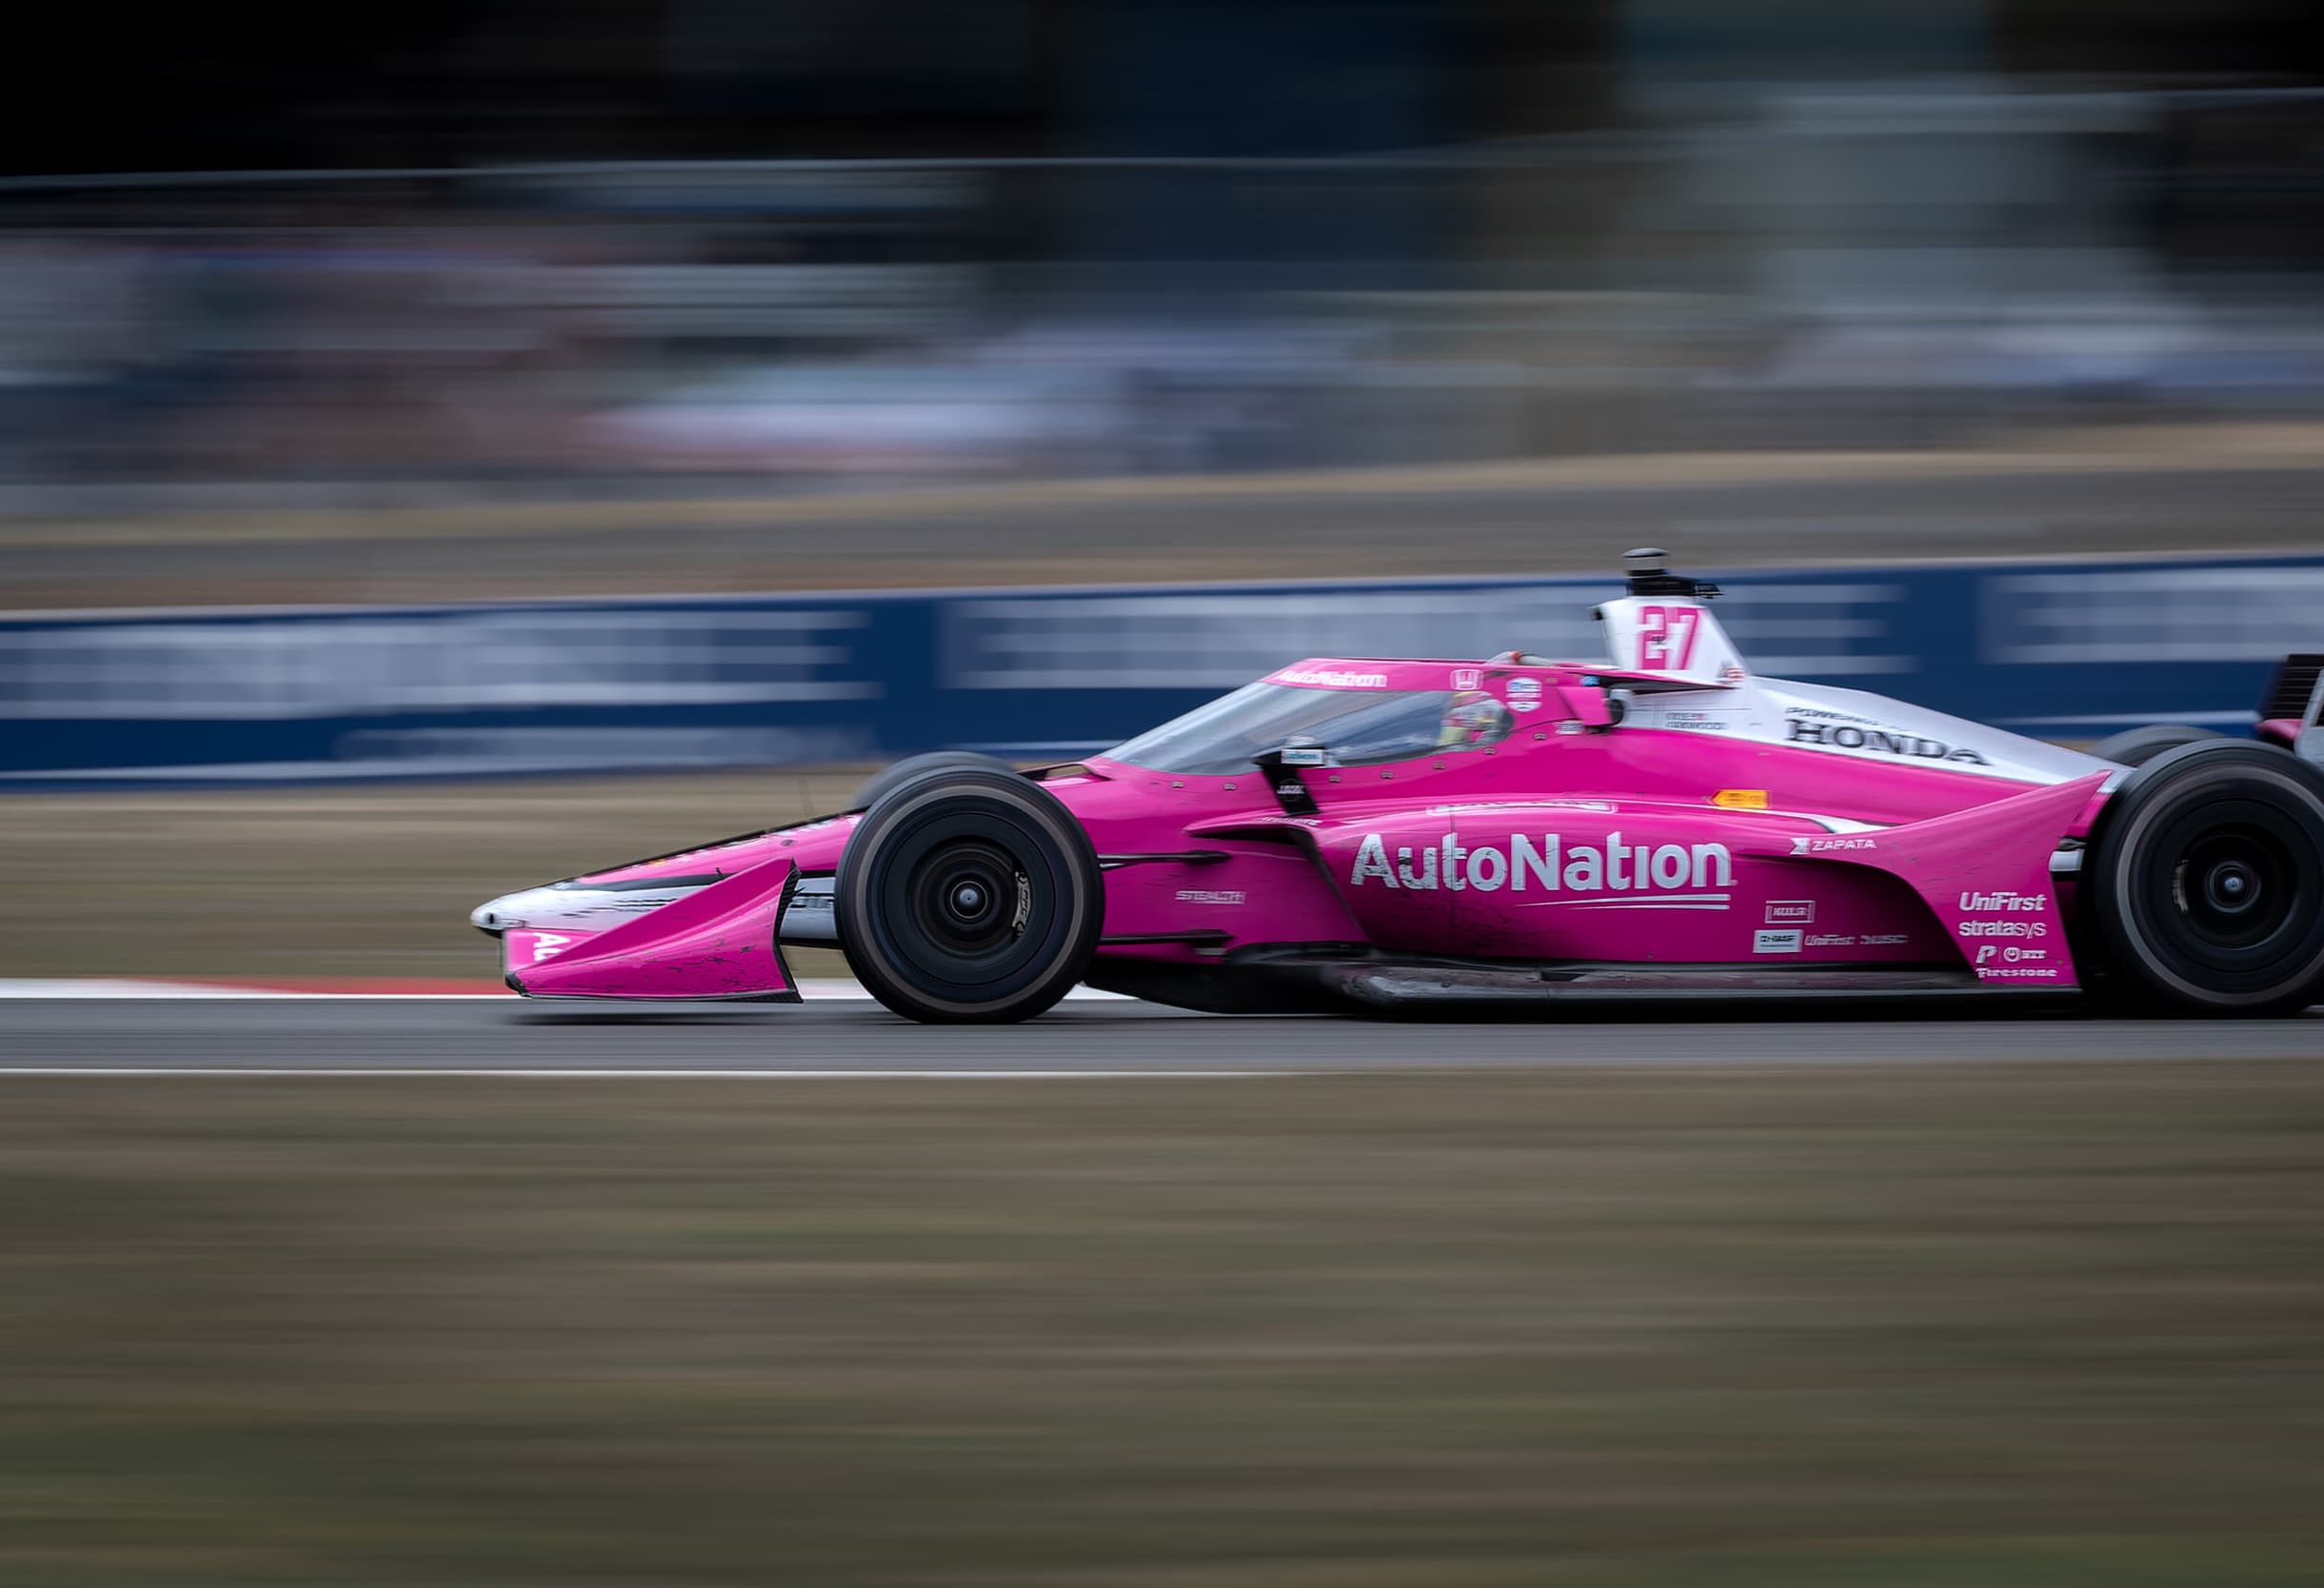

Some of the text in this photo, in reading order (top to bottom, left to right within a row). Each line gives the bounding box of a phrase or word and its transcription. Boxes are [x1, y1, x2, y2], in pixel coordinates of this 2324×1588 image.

[1636, 605, 1699, 670] 27
[1784, 719, 1994, 766] HONDA
[1812, 839, 1877, 851] ZAPATA
[1350, 831, 1733, 891] AutoNation
[1958, 891, 2047, 911] UniFirst
[1958, 921, 2047, 940] stratasys
[1975, 967, 2057, 979] Firestone
